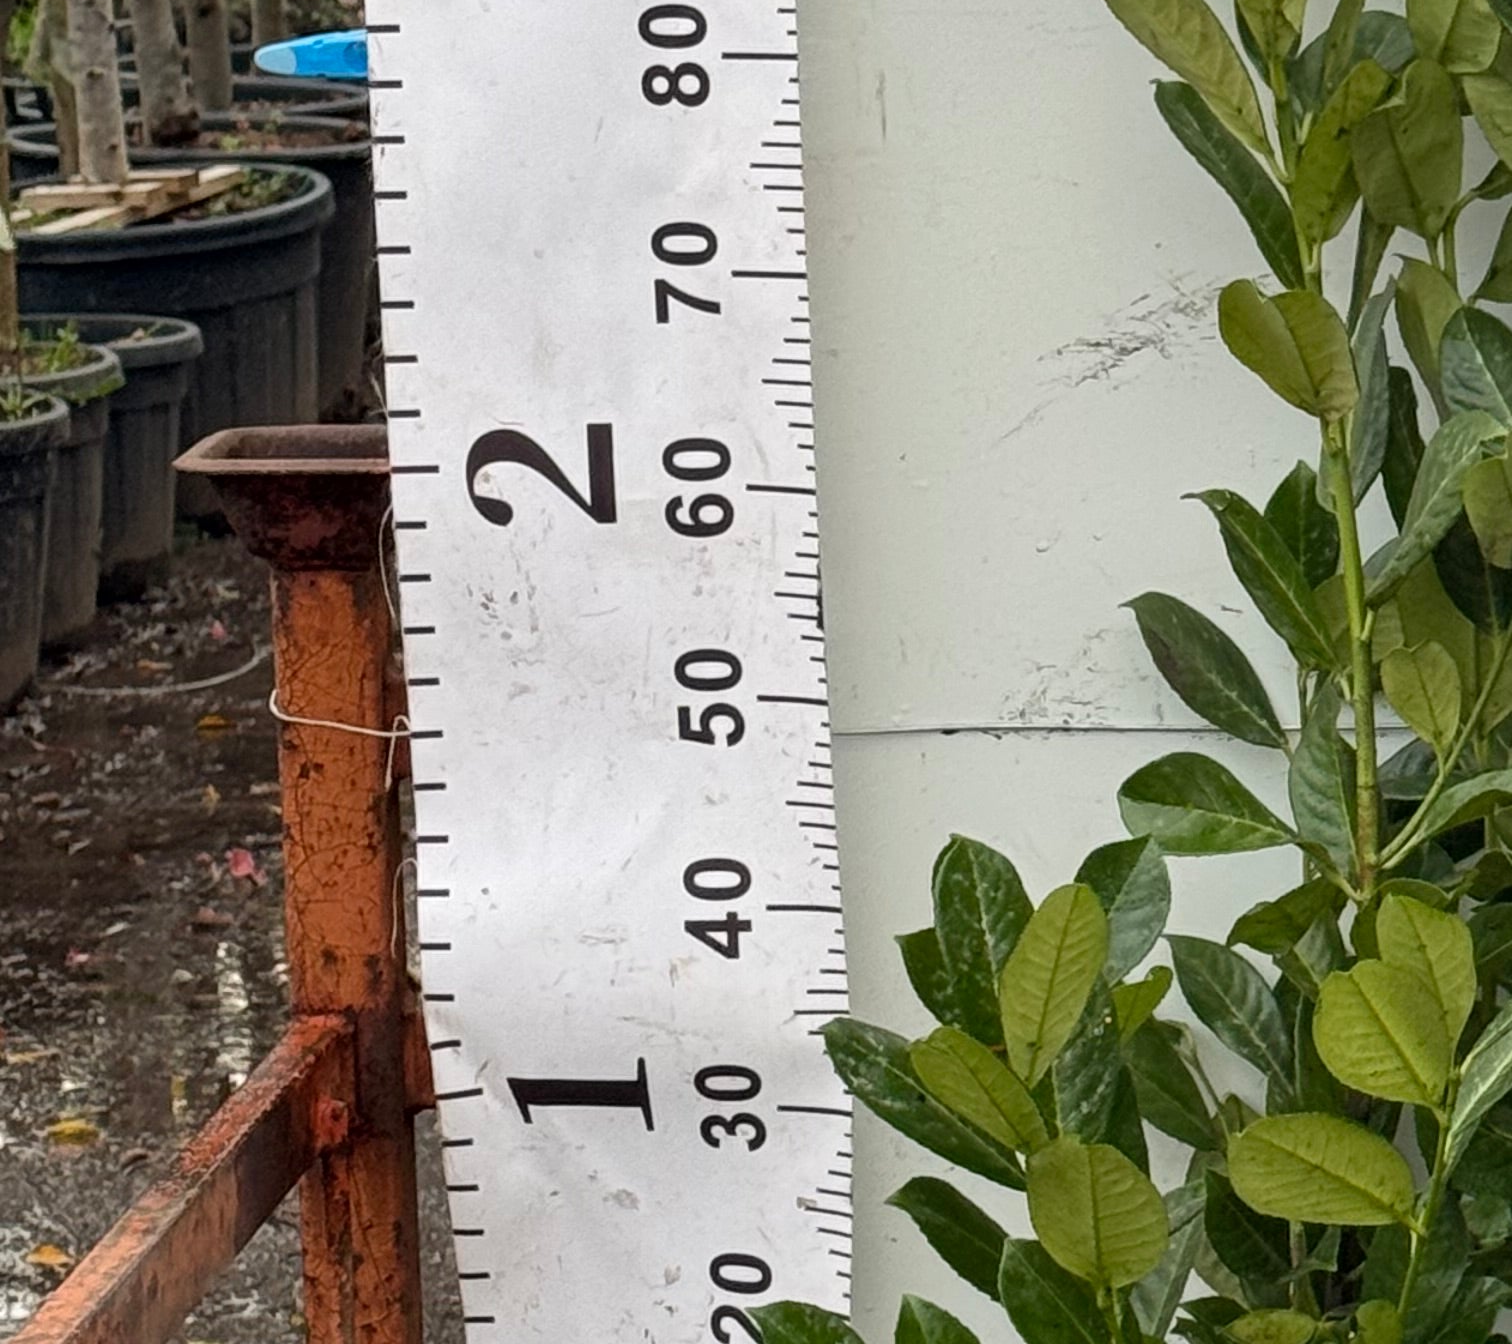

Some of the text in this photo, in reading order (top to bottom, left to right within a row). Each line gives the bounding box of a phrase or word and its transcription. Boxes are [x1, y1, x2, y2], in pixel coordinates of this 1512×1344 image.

[639, 4, 710, 107] 80
[652, 222, 721, 324] 70
[466, 423, 617, 527] 2
[662, 437, 734, 538] 60
[675, 648, 745, 747] 50
[684, 858, 752, 959] 40
[507, 1057, 655, 1132] 1
[694, 1064, 767, 1152] 30
